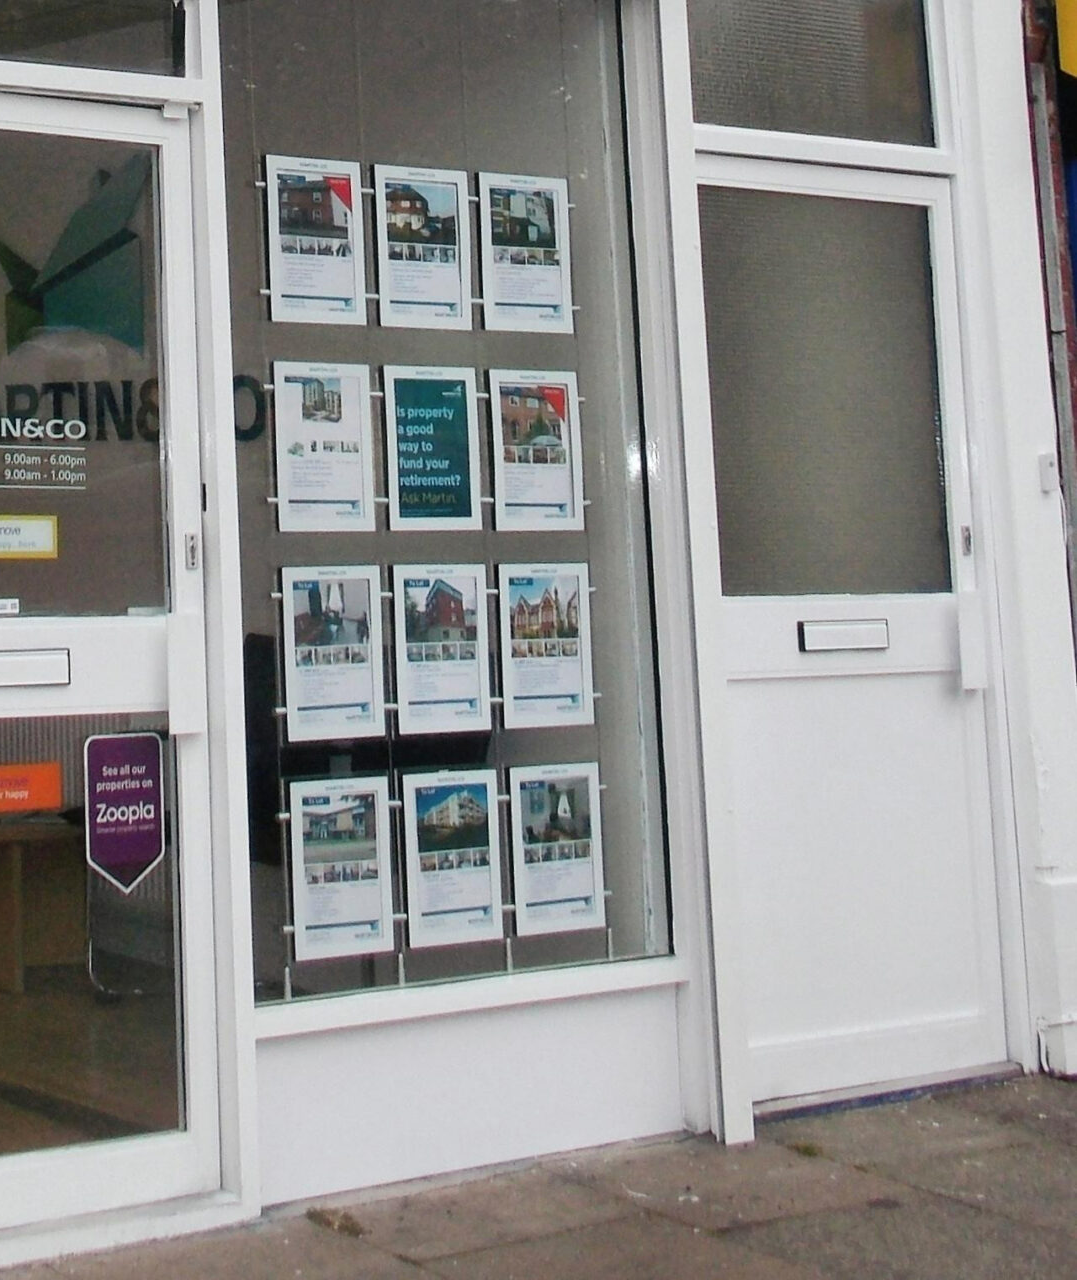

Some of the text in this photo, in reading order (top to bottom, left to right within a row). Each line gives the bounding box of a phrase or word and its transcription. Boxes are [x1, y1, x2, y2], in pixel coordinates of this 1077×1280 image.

[407, 406, 454, 420] property
[397, 423, 434, 436] a good
[398, 441, 433, 454] way to
[4, 453, 41, 465] 9.00am
[50, 454, 87, 469] 6.00pm
[399, 456, 450, 471] fund your
[4, 469, 41, 481] 9.00am
[51, 469, 87, 484] 1.00pm
[400, 474, 461, 486] retirement?
[401, 492, 419, 504] Ask
[102, 764, 146, 777] See all our
[96, 779, 153, 793] properties on
[5, 790, 29, 800] happy
[96, 800, 155, 825] Zoopla
